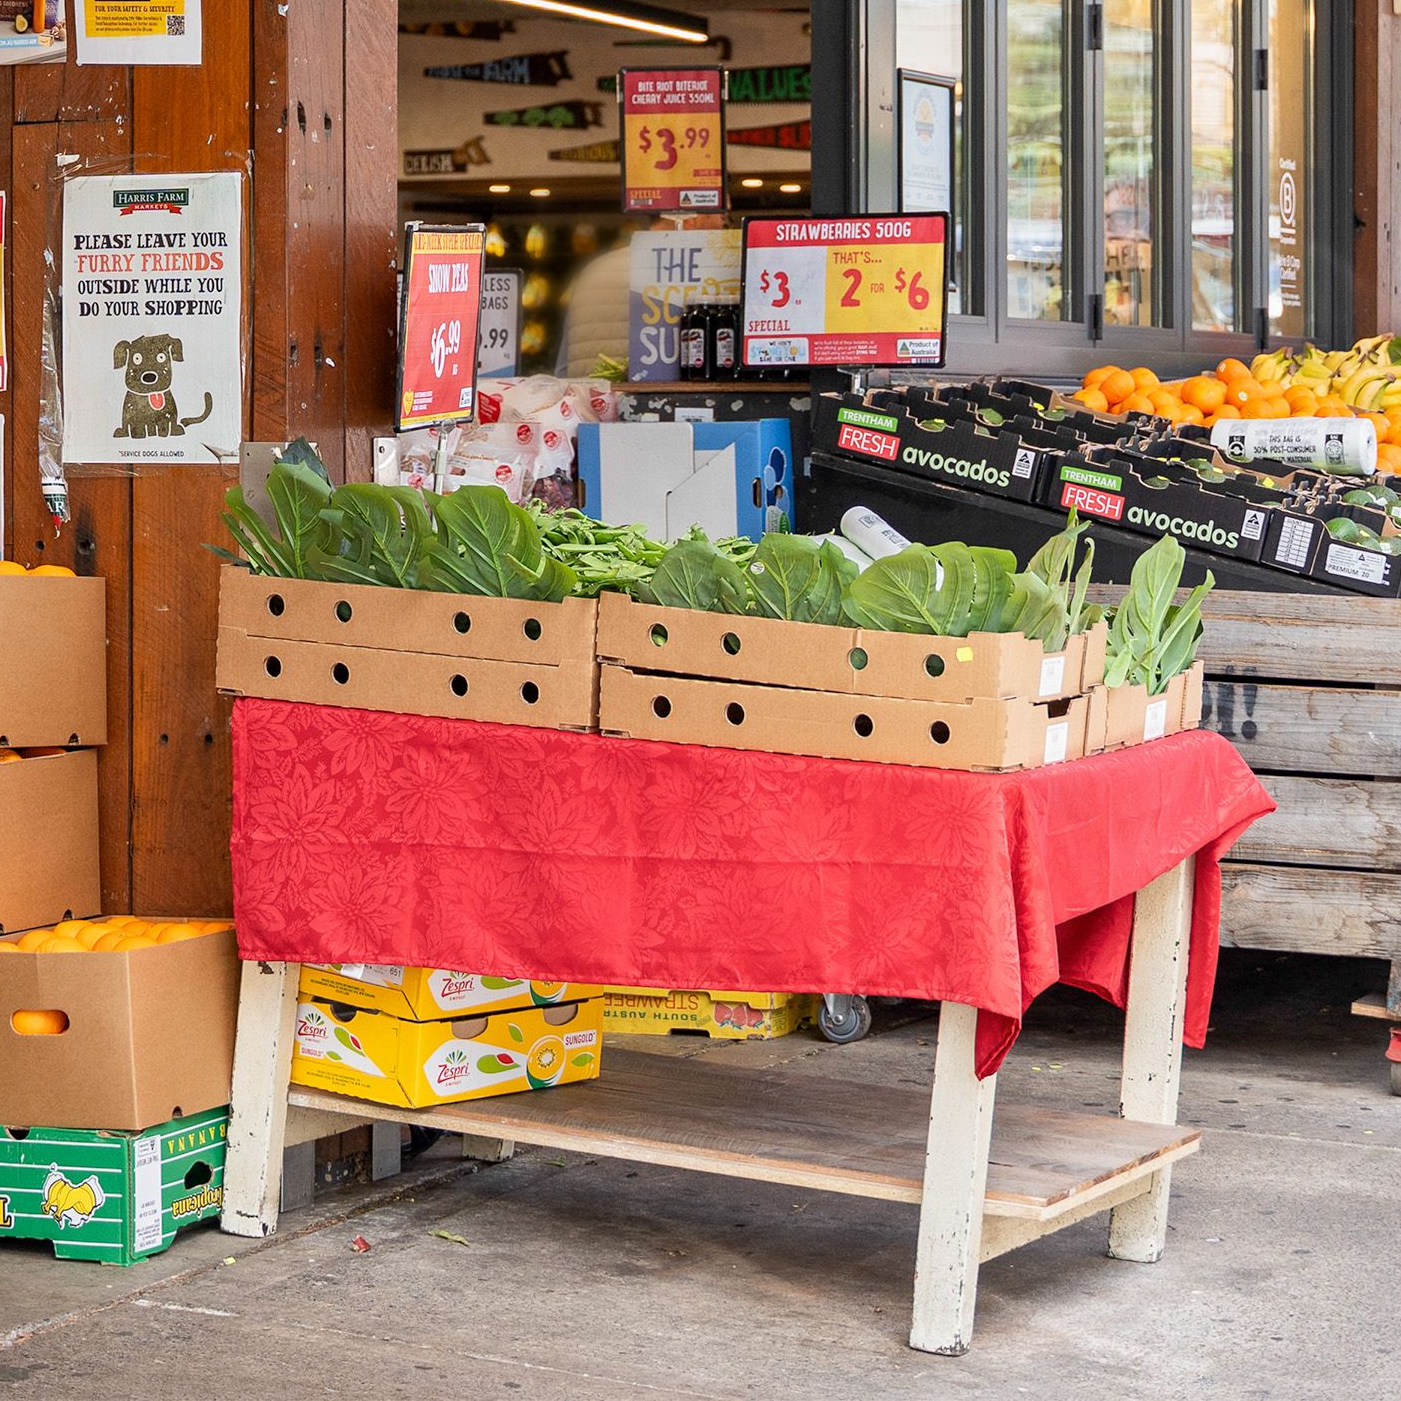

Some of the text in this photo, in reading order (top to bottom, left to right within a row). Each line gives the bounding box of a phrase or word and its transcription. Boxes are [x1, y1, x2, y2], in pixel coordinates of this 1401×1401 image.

[638, 82, 654, 92] BITE
[656, 82, 673, 91] RIOT
[632, 94, 661, 104] CHERRY
[664, 94, 686, 104] JUICE
[639, 126, 709, 170] $3.99
[118, 192, 184, 204] HARRIS FARM
[74, 232, 227, 250] PLEASE LEAVE YOUR
[777, 222, 911, 241] STRAWBERRIES 500G
[78, 252, 223, 273] FURRY FRIENDS
[652, 248, 702, 282] THE
[78, 278, 223, 294] OUTSIDE WHILE YOU
[429, 263, 469, 293] SNOW PEAS
[760, 270, 790, 307] $3
[840, 268, 929, 310] 2 FOR $6
[79, 300, 222, 316] DO YOUR SHOPPING
[481, 297, 508, 310] BAGS
[749, 320, 790, 331] SPECIAL
[842, 410, 895, 429] TRENTHAM
[842, 428, 897, 457] FRESH
[902, 446, 1010, 487] avocados
[1064, 469, 1119, 488] TRENTHAM
[1065, 487, 1121, 516] FRESH
[1127, 507, 1239, 549] avocados
[1328, 564, 1359, 577] PREMIUM
[441, 978, 474, 997] Zespri
[653, 1012, 697, 1021] SOUTH
[298, 1020, 329, 1037] Zespri
[438, 1063, 470, 1084] Zespri
[167, 1128, 227, 1152] BANANA
